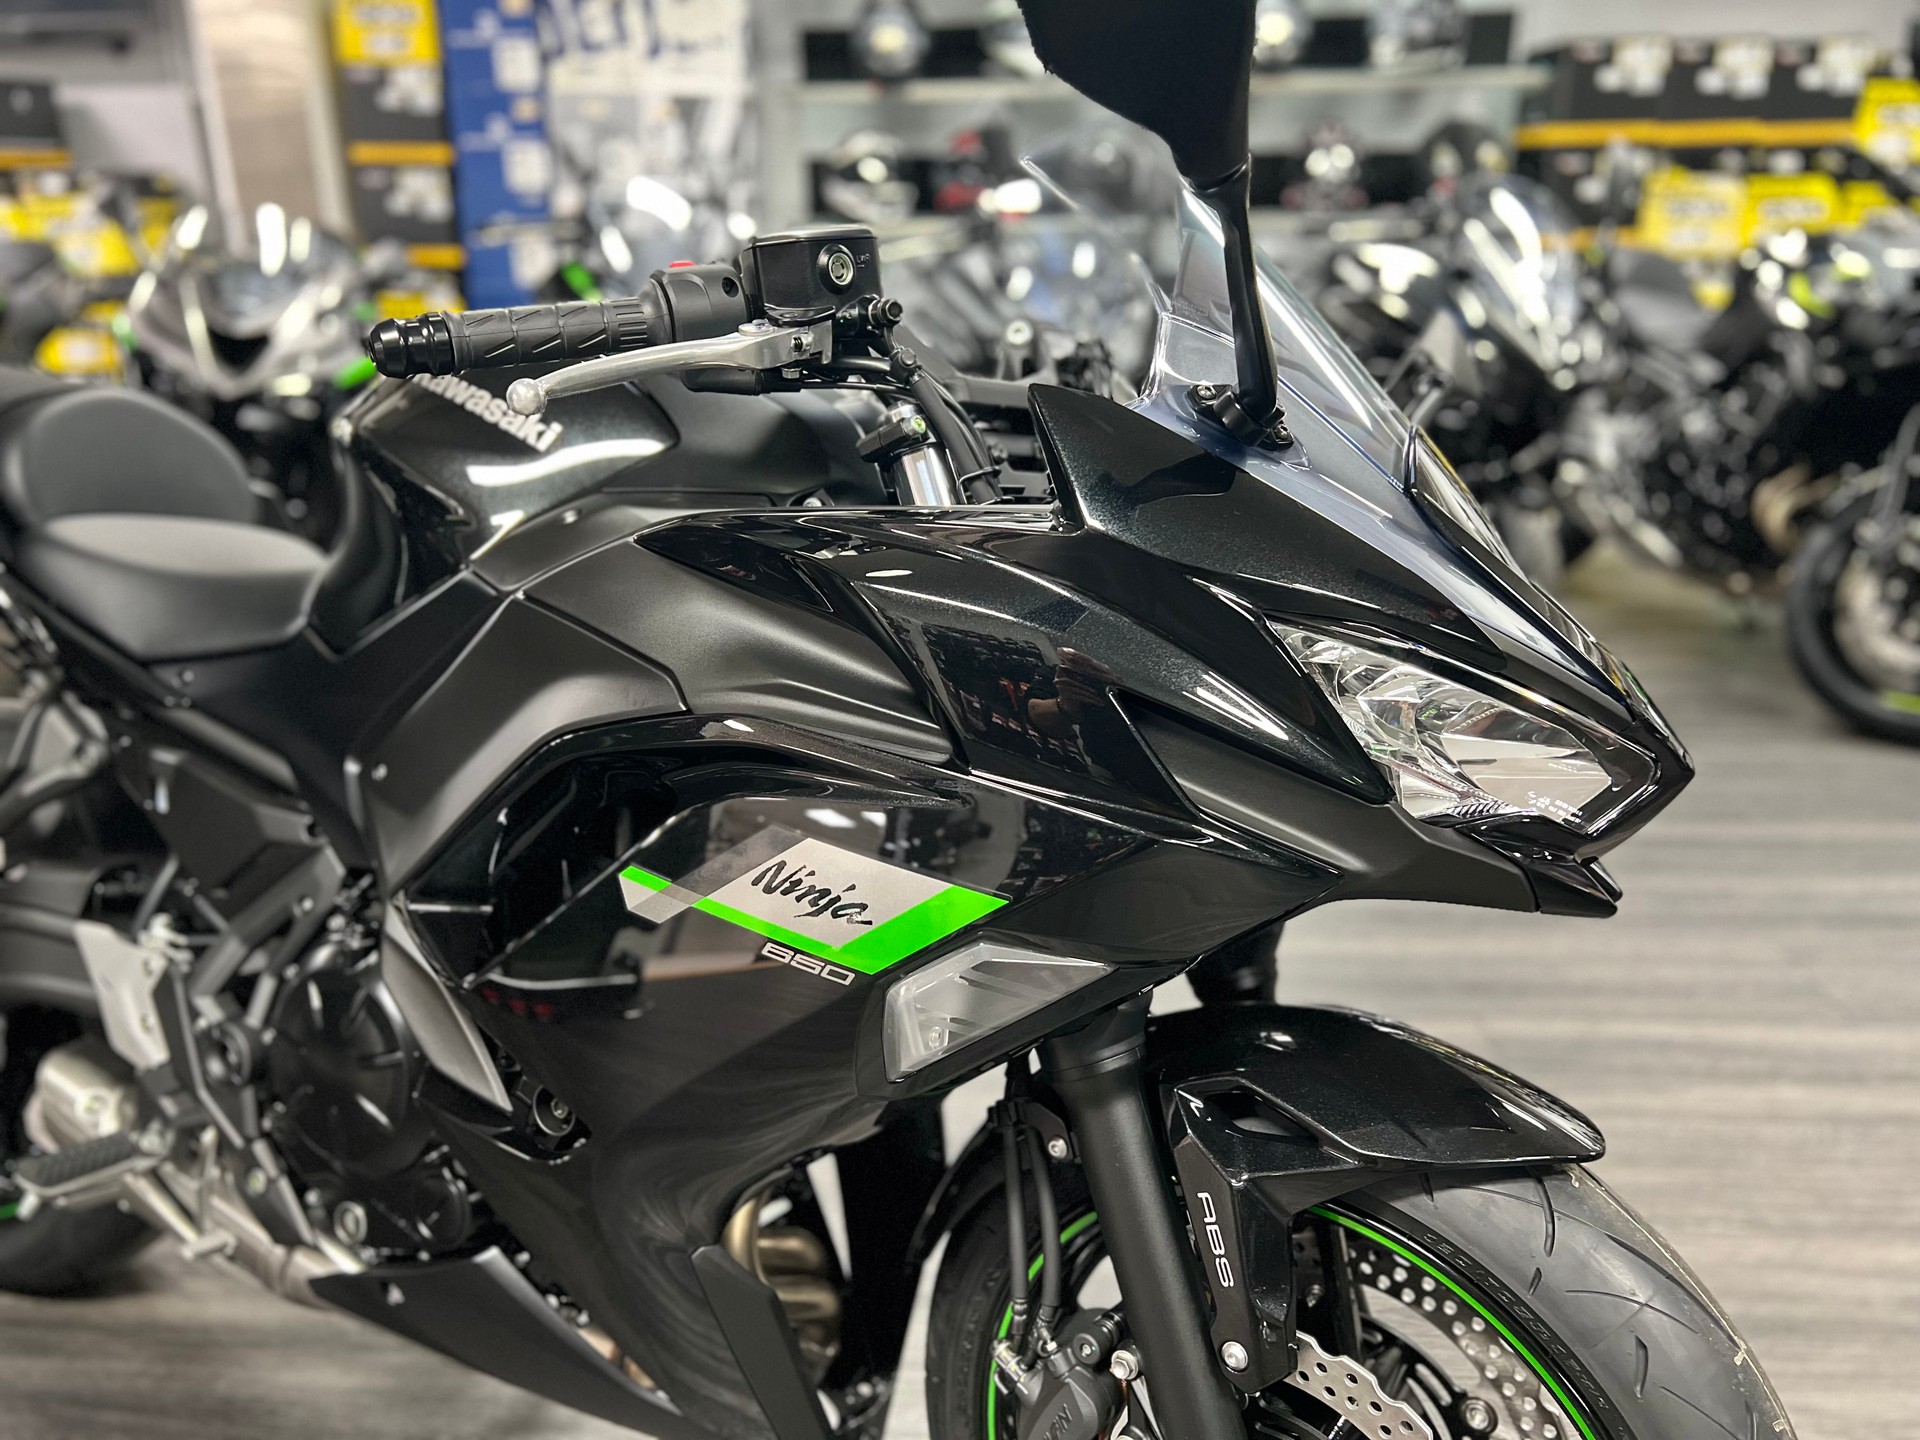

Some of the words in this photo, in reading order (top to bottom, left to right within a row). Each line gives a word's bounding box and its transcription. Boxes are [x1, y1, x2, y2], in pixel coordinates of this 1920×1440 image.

[751, 860, 873, 925] Ninja
[761, 942, 856, 986] 650
[1196, 1192, 1235, 1288] ABS
